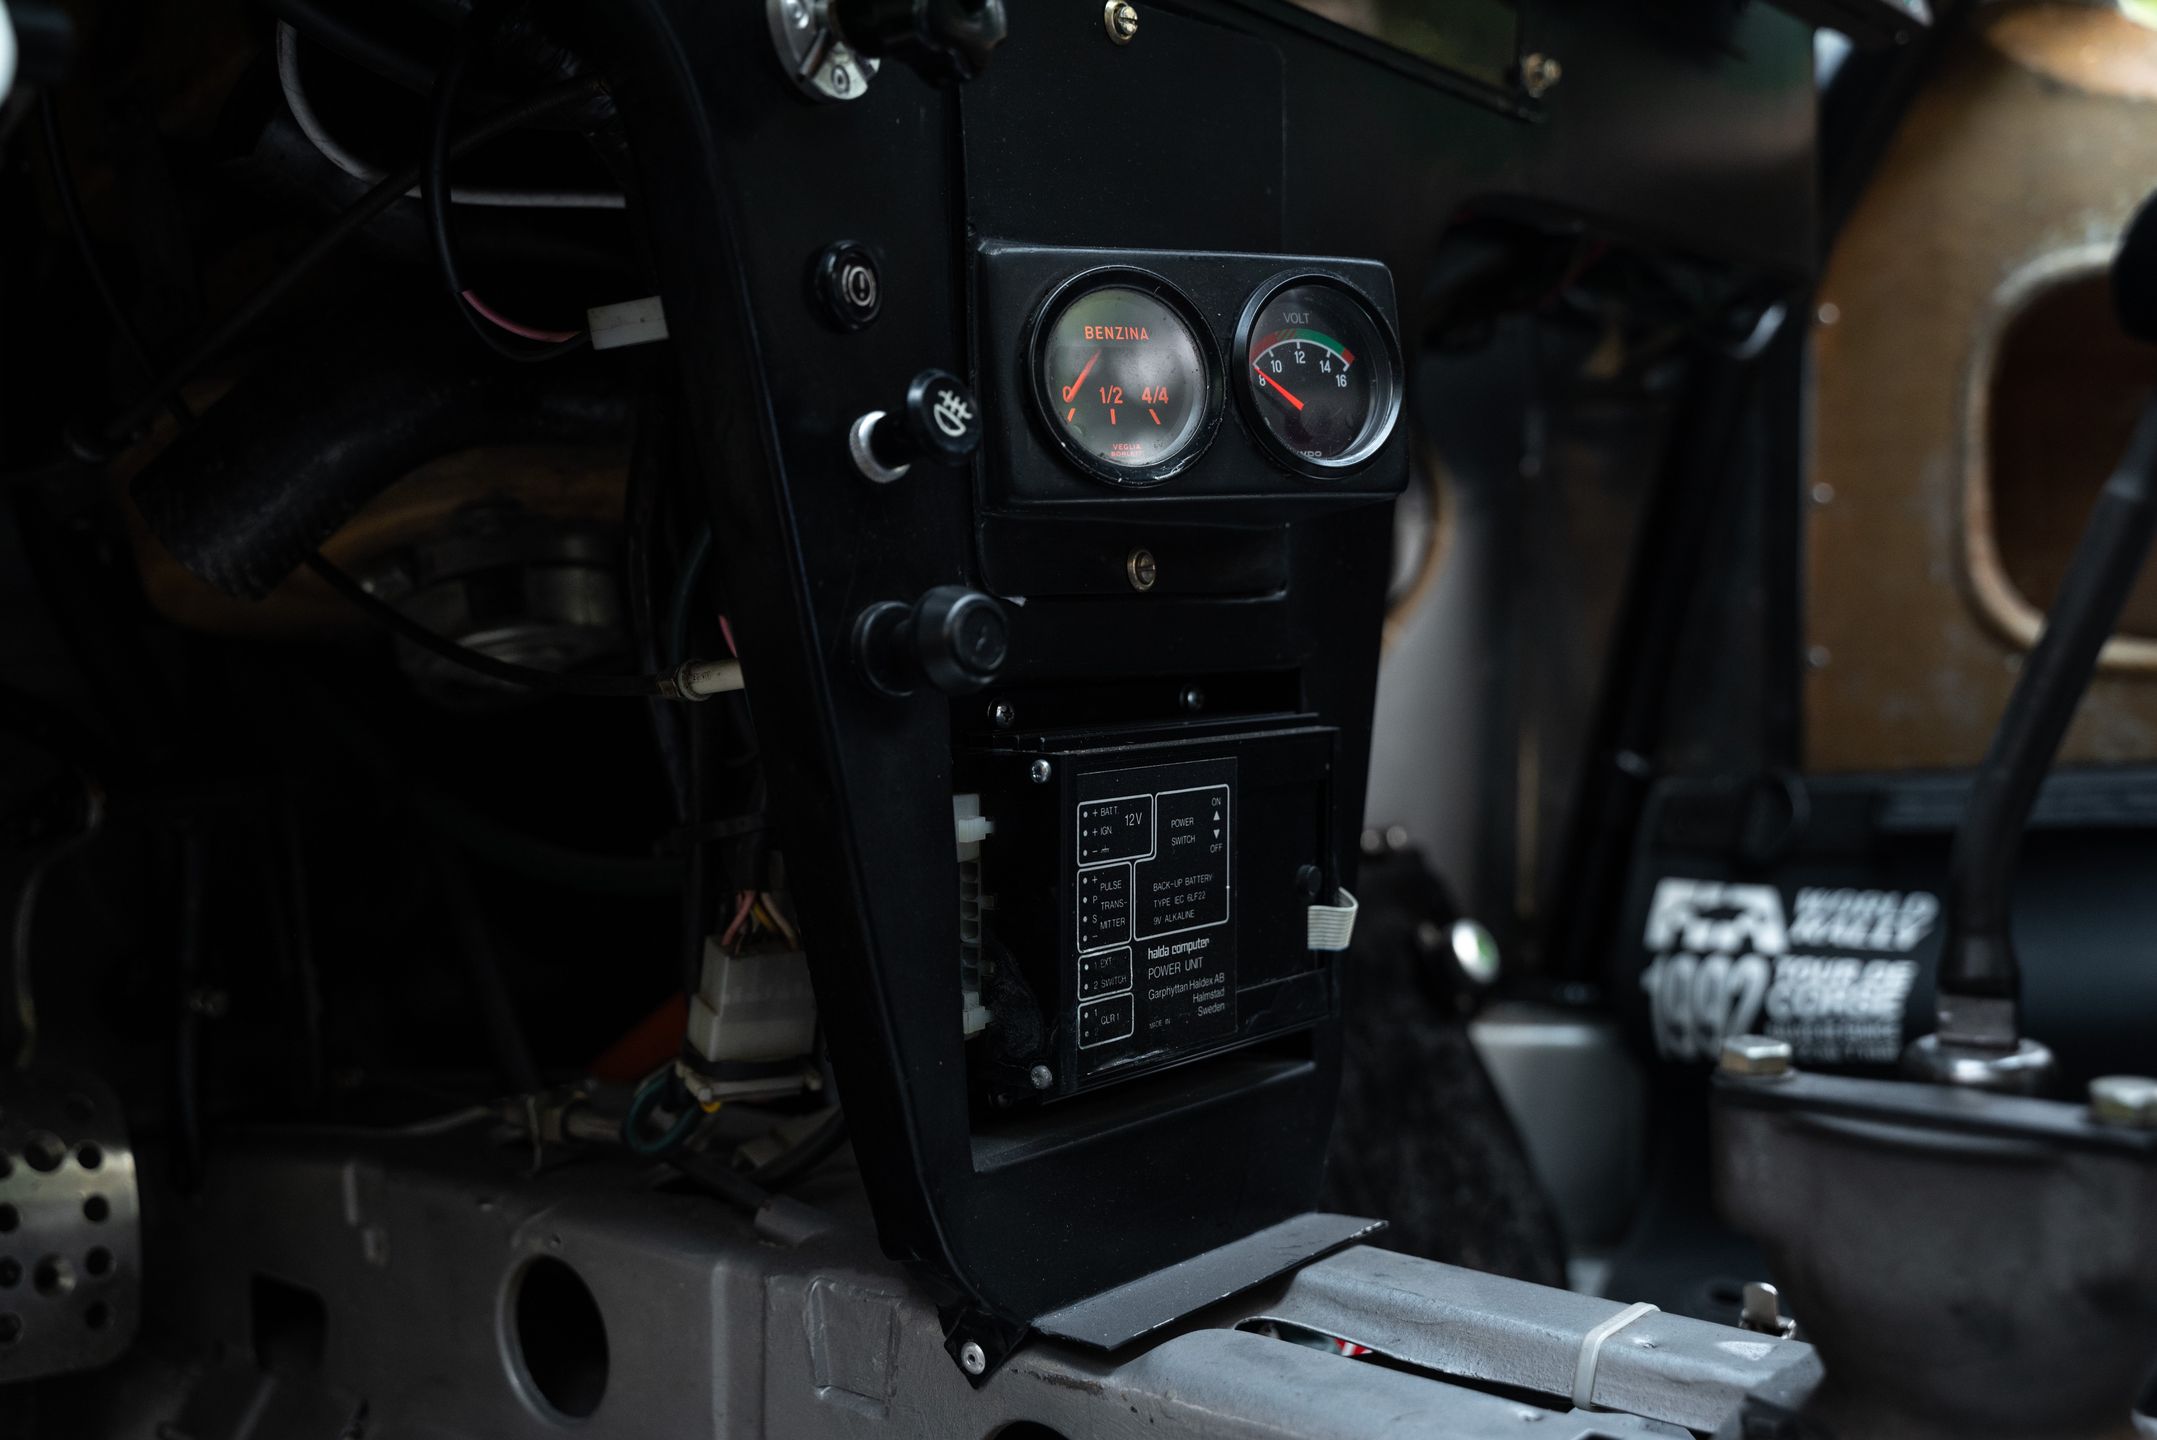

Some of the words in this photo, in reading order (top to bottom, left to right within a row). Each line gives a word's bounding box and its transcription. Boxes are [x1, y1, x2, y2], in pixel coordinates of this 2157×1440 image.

[1283, 312, 1310, 324] VOLT
[1084, 325, 1149, 341] BENZINA
[1270, 359, 1282, 374] 10
[1294, 351, 1306, 364] 12
[1319, 359, 1331, 374] 14
[1335, 374, 1348, 388] 16
[1099, 384, 1124, 404] 1/2
[1141, 386, 1169, 405] 4/4
[1211, 797, 1222, 806] ON
[1125, 812, 1143, 826] 12V
[1171, 817, 1194, 828] POWER
[1171, 835, 1196, 846] SWITCH
[1210, 843, 1223, 853] OFF
[1100, 880, 1122, 891] PULSE
[1153, 879, 1183, 891] BACK-UP
[1185, 873, 1213, 886] BATTERY
[1101, 901, 1128, 910] TRANS-
[1154, 899, 1171, 908] TYPE
[1174, 895, 1184, 905] IEC
[1092, 915, 1097, 923] S
[1100, 917, 1126, 930] MITTER
[1153, 917, 1162, 926] 9V
[1164, 909, 1195, 923] ALKALINE
[1148, 945, 1169, 960] halda
[1171, 937, 1210, 955] computer
[1148, 963, 1181, 980] POWER
[1184, 957, 1203, 972] UNIT
[1101, 976, 1127, 989] SWITCH
[1148, 983, 1189, 1000] Garphyttan
[1189, 977, 1213, 990] Haldex
[1213, 973, 1225, 984] AB
[1193, 989, 1225, 1004] Halmstad
[1198, 1004, 1225, 1017] Sweden
[1101, 1015, 1115, 1025] CLR
